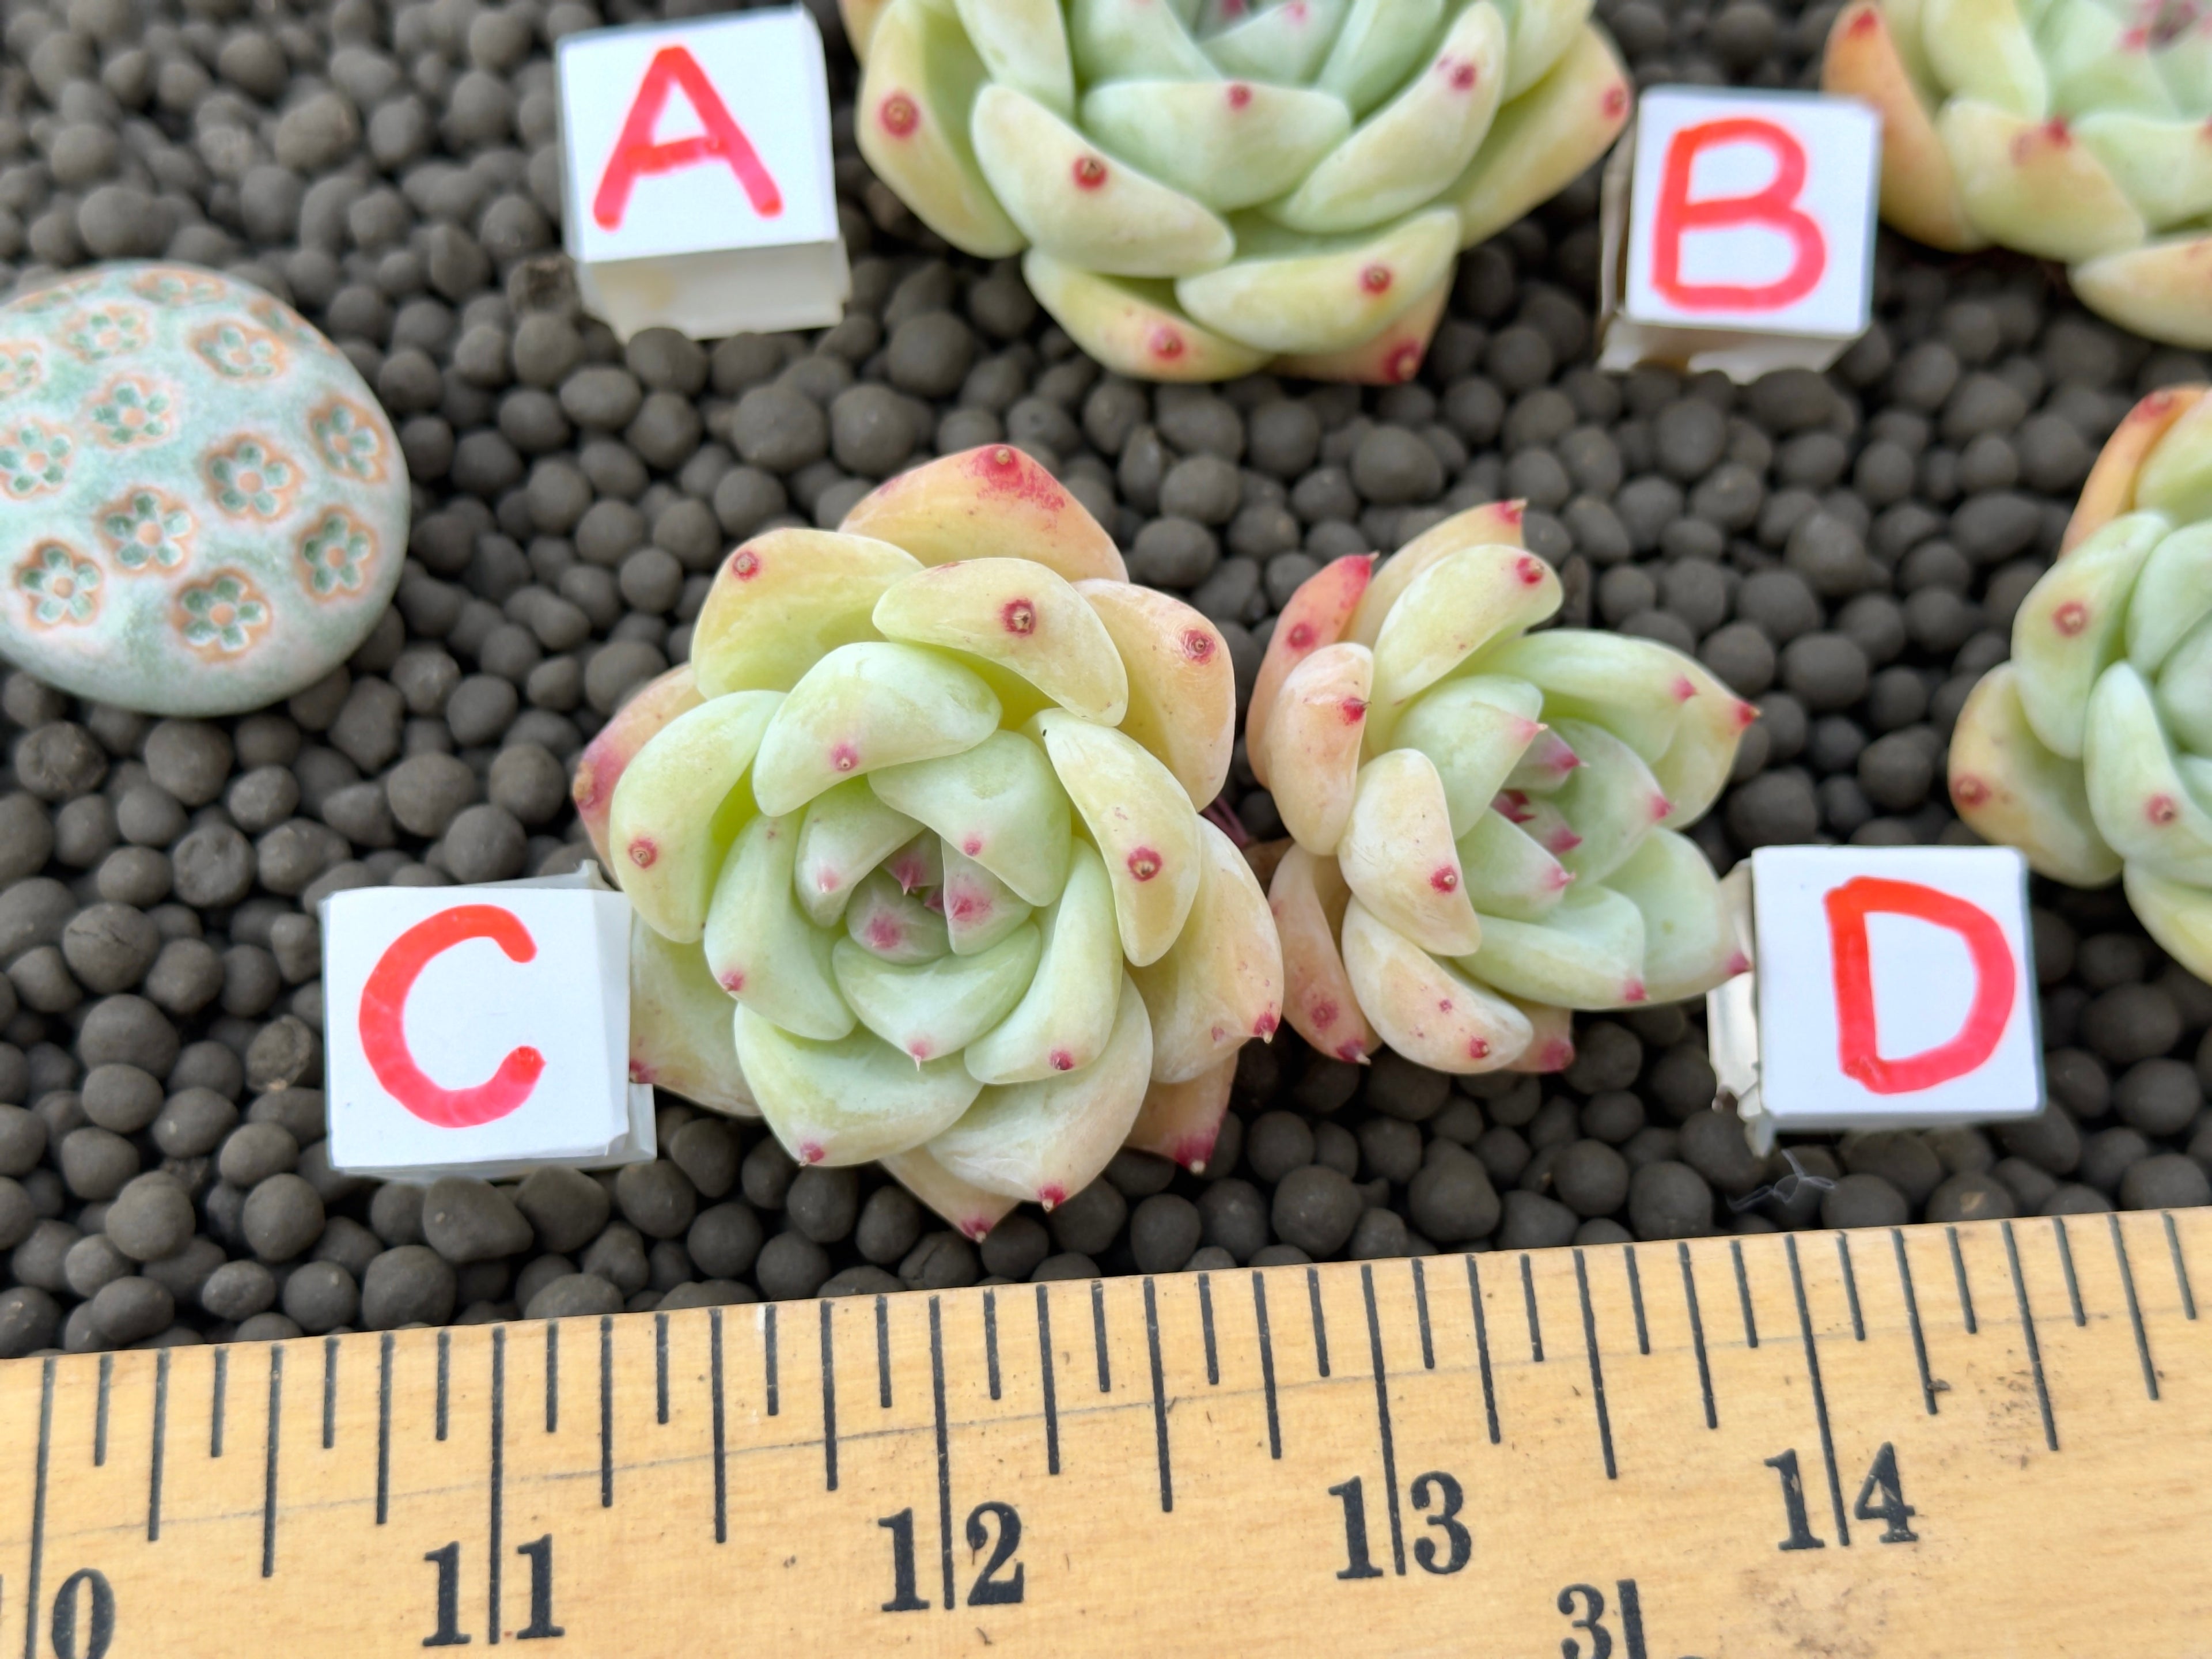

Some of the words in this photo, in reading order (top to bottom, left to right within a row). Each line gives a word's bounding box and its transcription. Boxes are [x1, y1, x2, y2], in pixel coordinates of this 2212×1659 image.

[593, 46, 782, 230] A
[1651, 117, 1827, 313] B
[358, 904, 546, 1129] C
[1823, 876, 2017, 1096] D
[422, 1535, 565, 1647] 11
[877, 1501, 1025, 1613] 12
[1328, 1471, 1472, 1581] 13
[1764, 1442, 1919, 1551] 14
